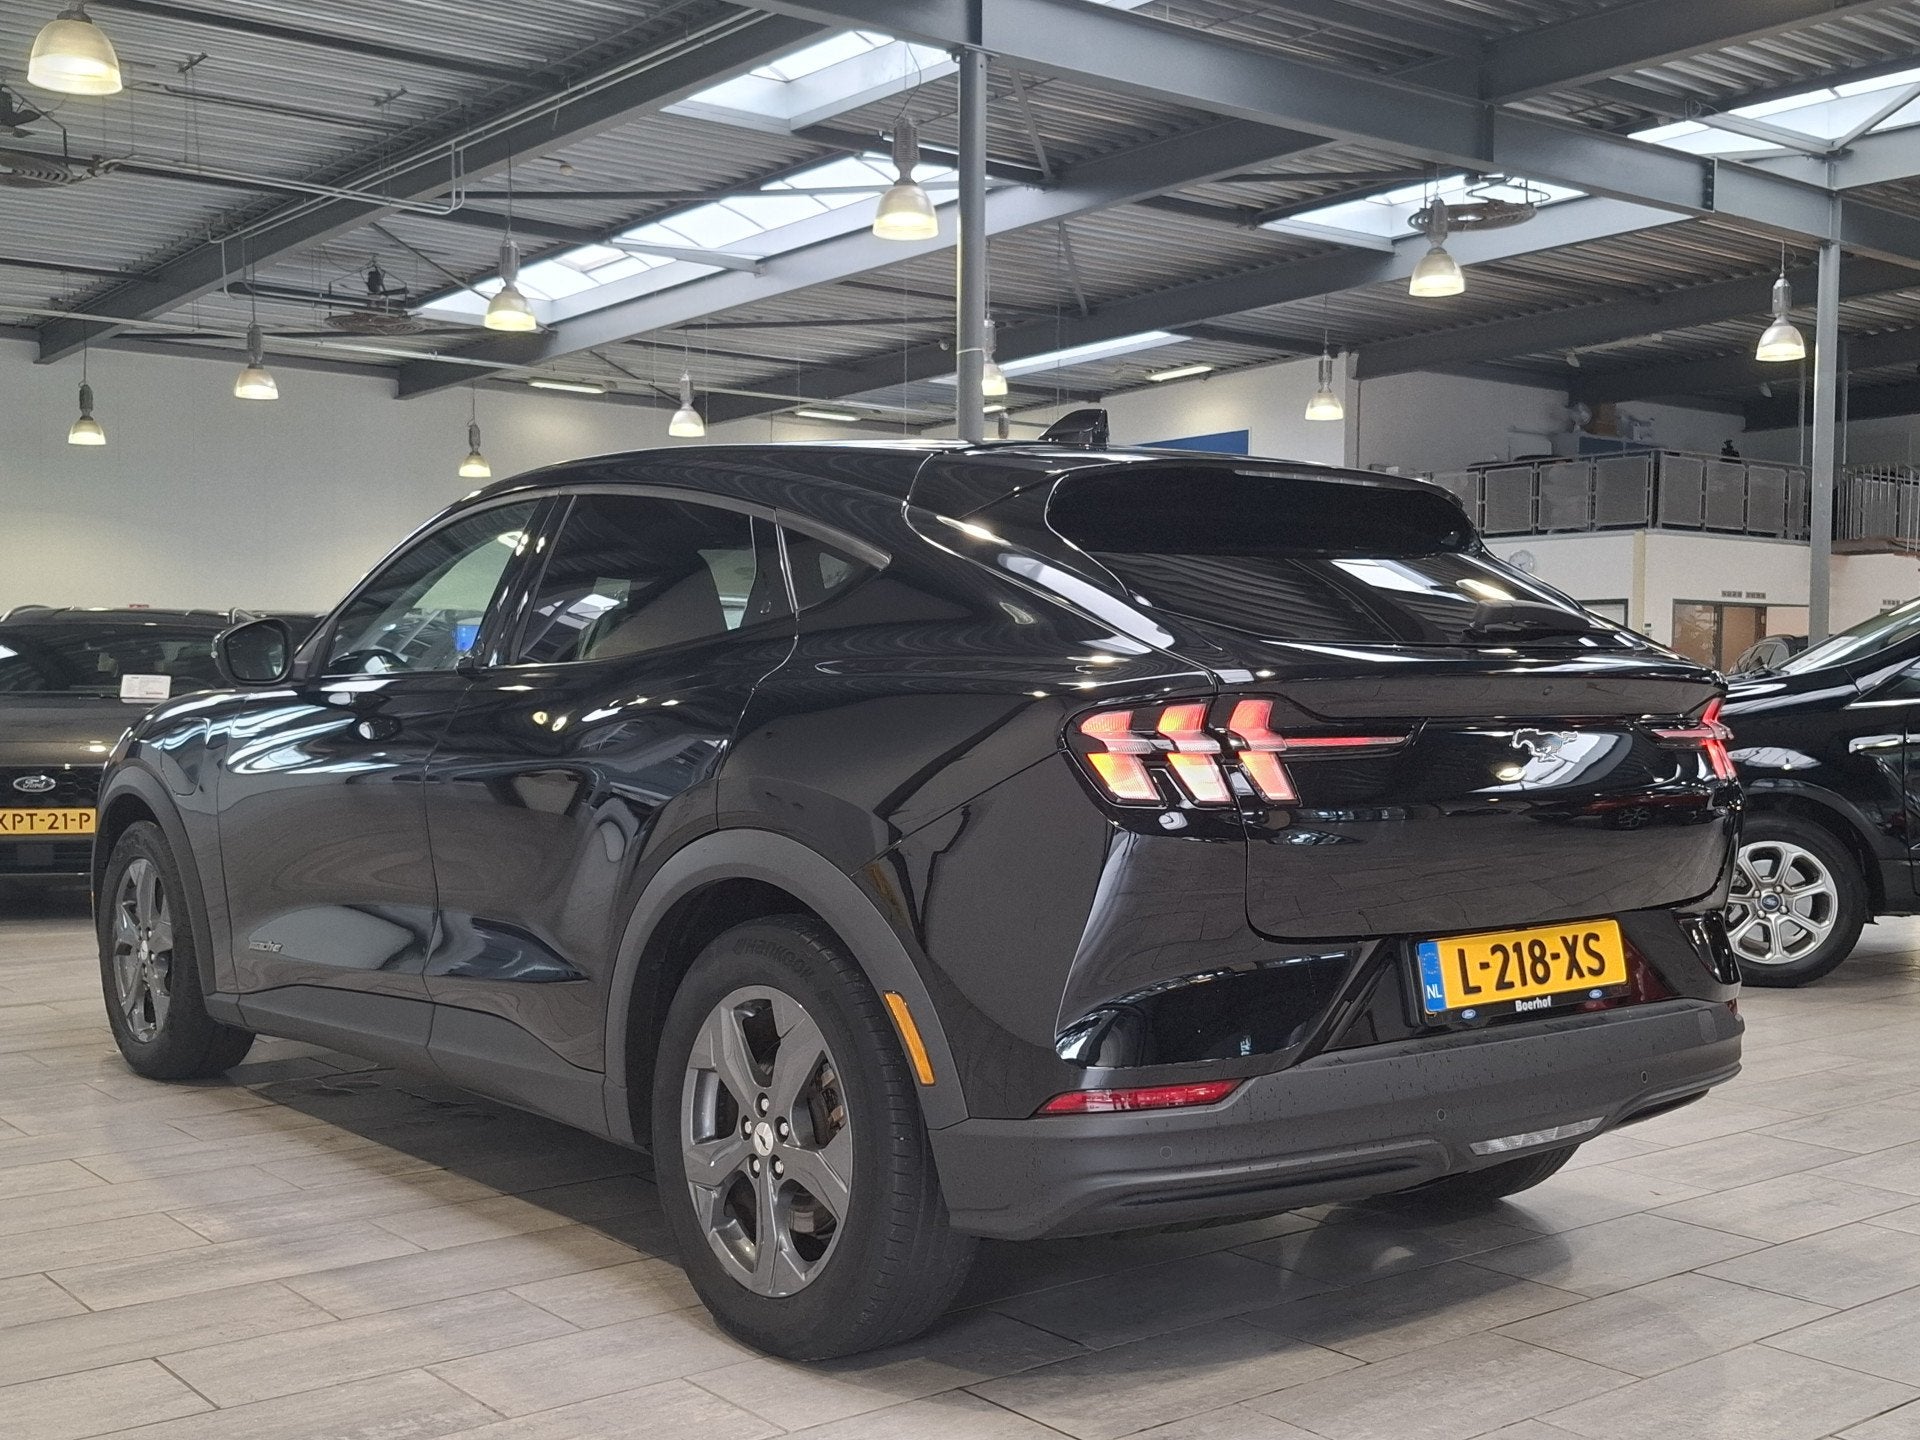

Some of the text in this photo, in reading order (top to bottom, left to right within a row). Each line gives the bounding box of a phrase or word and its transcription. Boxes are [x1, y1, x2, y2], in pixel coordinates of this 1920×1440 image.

[1457, 932, 1606, 995] L-218-XS
[1426, 982, 1443, 999] NL
[1515, 995, 1552, 1012] Boerhof
